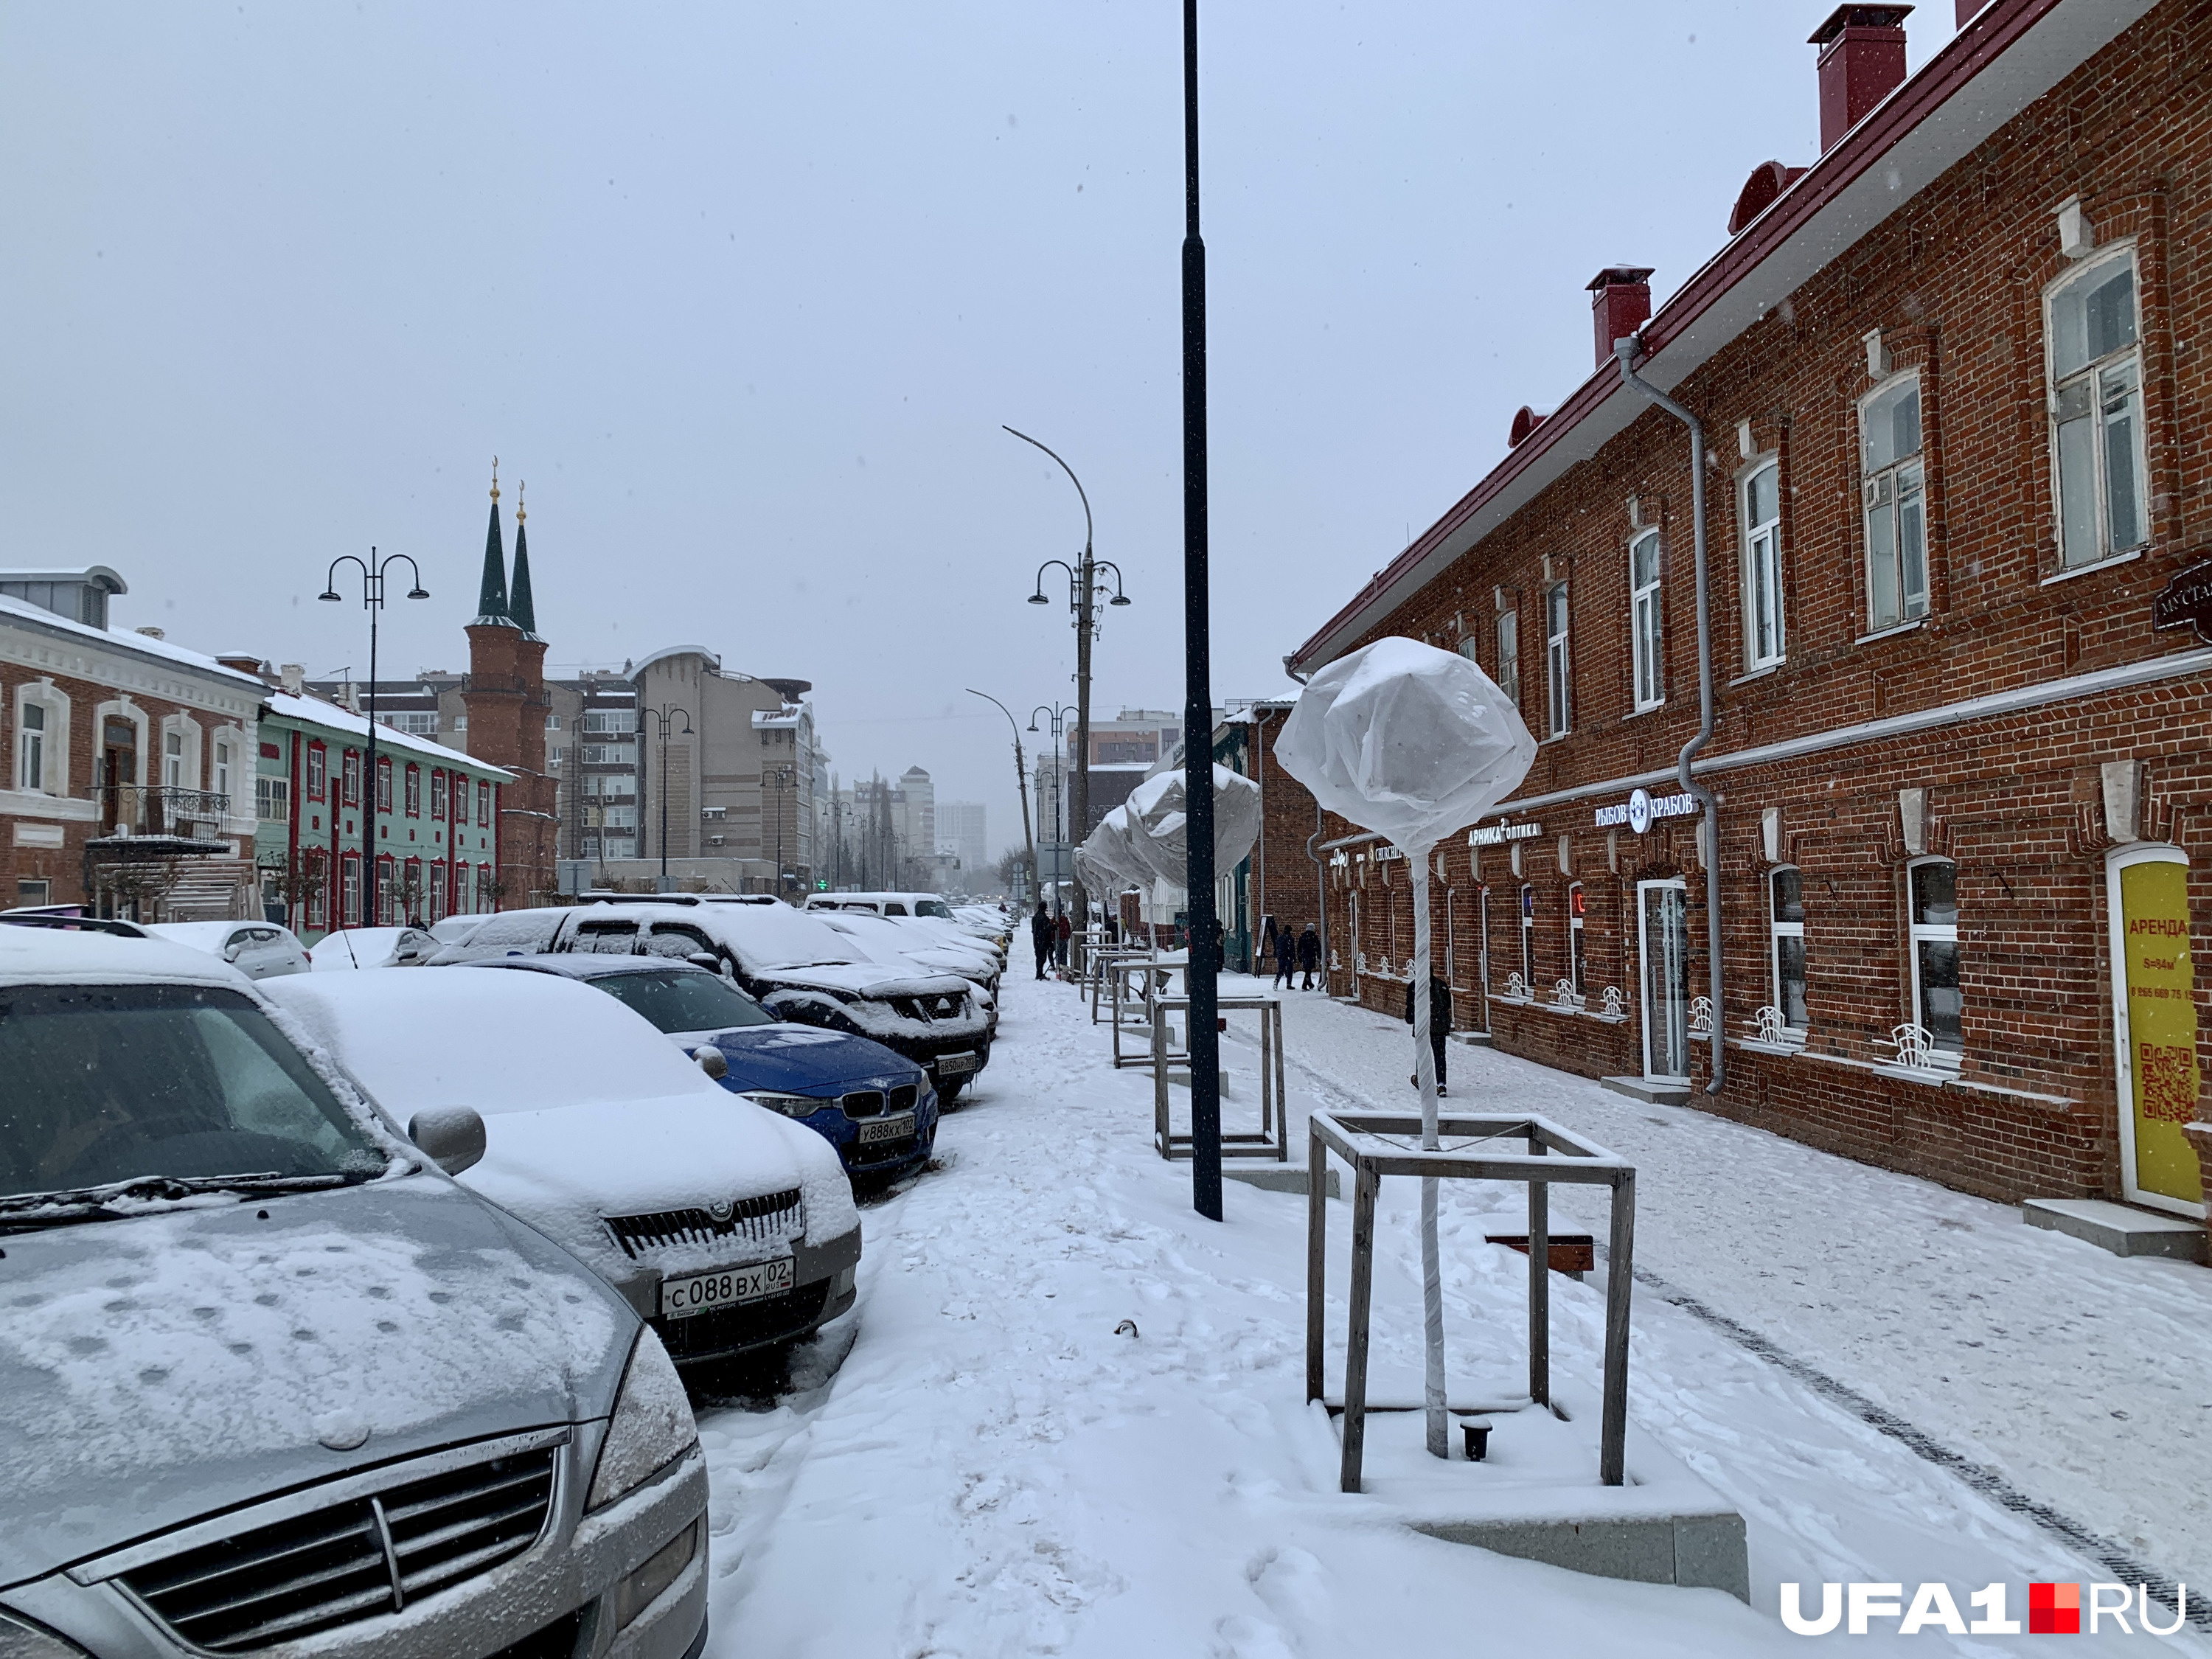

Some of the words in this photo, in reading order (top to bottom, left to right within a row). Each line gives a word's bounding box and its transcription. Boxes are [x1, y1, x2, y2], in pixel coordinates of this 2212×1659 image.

[1595, 804, 1627, 827] РЫБОВ
[1649, 793, 1694, 818] КРАБОВ
[2129, 919, 2188, 939] АРЕНДА
[2171, 989, 2182, 999] 75
[902, 1118, 914, 1131] 102
[672, 1273, 762, 1308] С088ВХ
[768, 1262, 787, 1282] 02
[765, 1281, 781, 1291] RUS
